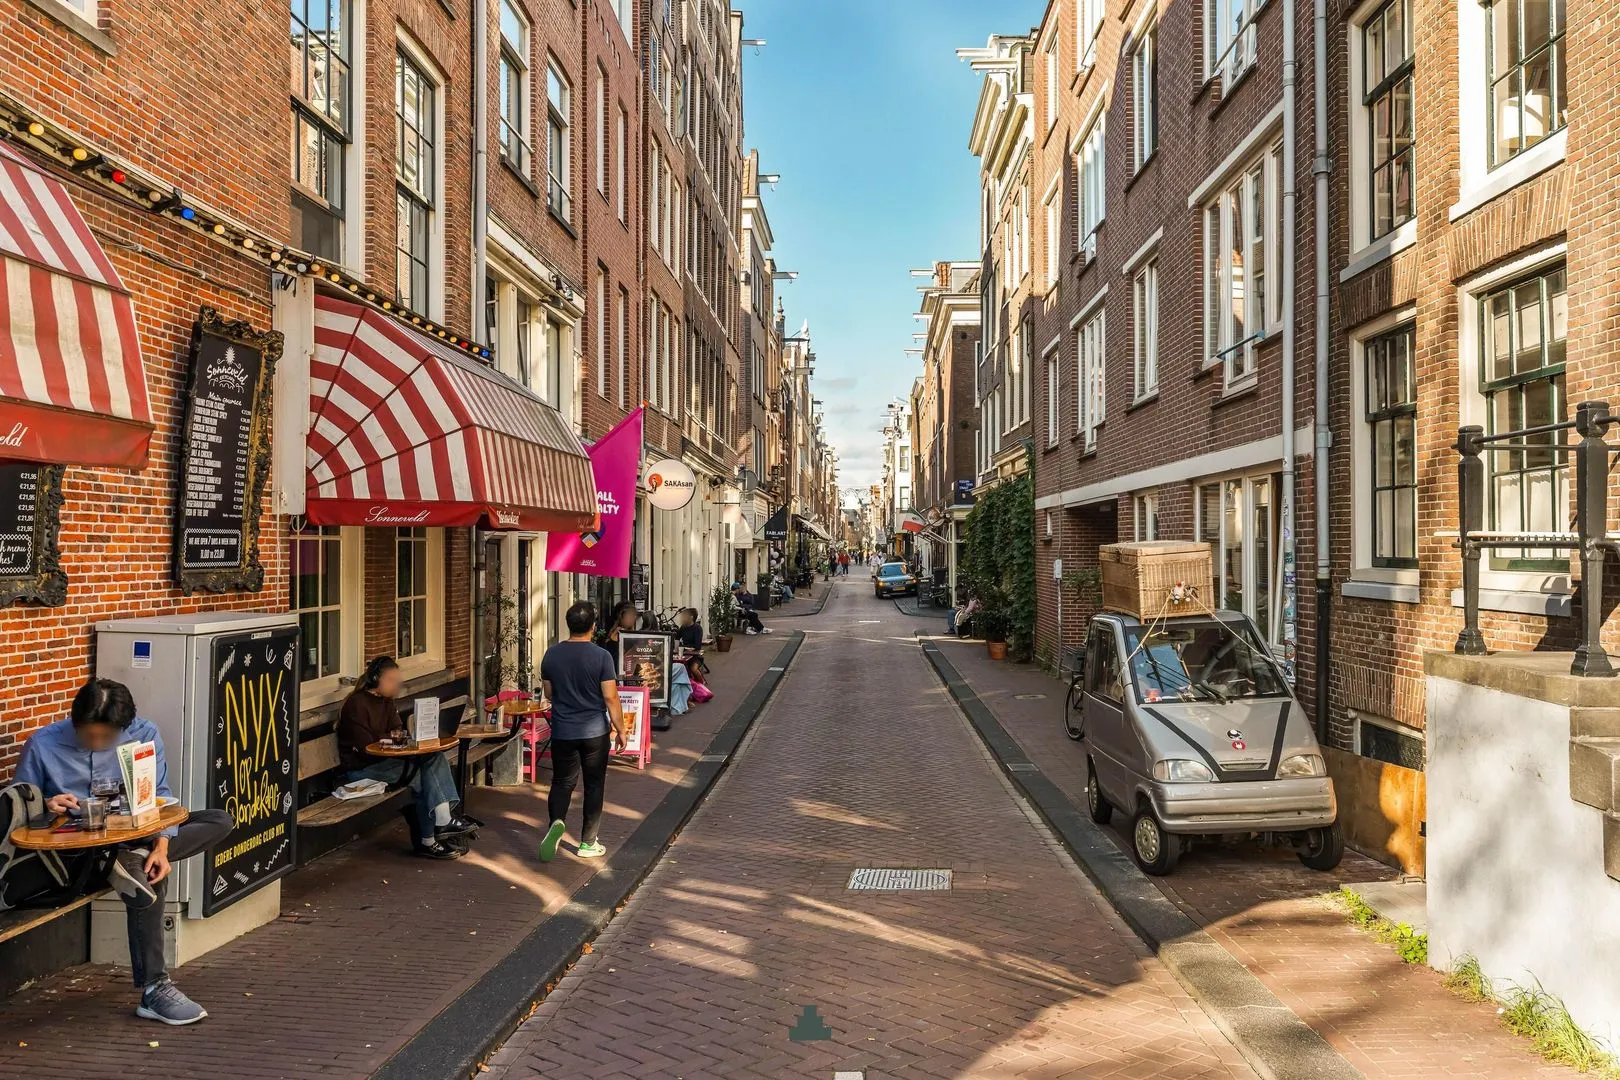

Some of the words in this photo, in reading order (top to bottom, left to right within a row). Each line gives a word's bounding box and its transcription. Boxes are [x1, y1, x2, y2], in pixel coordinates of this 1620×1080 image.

[21, 472, 37, 480] €21,95
[20, 483, 36, 491] €21,95
[365, 506, 431, 522] Sonneveld
[225, 669, 284, 773] NYX
[215, 846, 233, 868] IEDERE
[233, 833, 262, 859] DONDERDAG
[262, 826, 275, 843] CLUB
